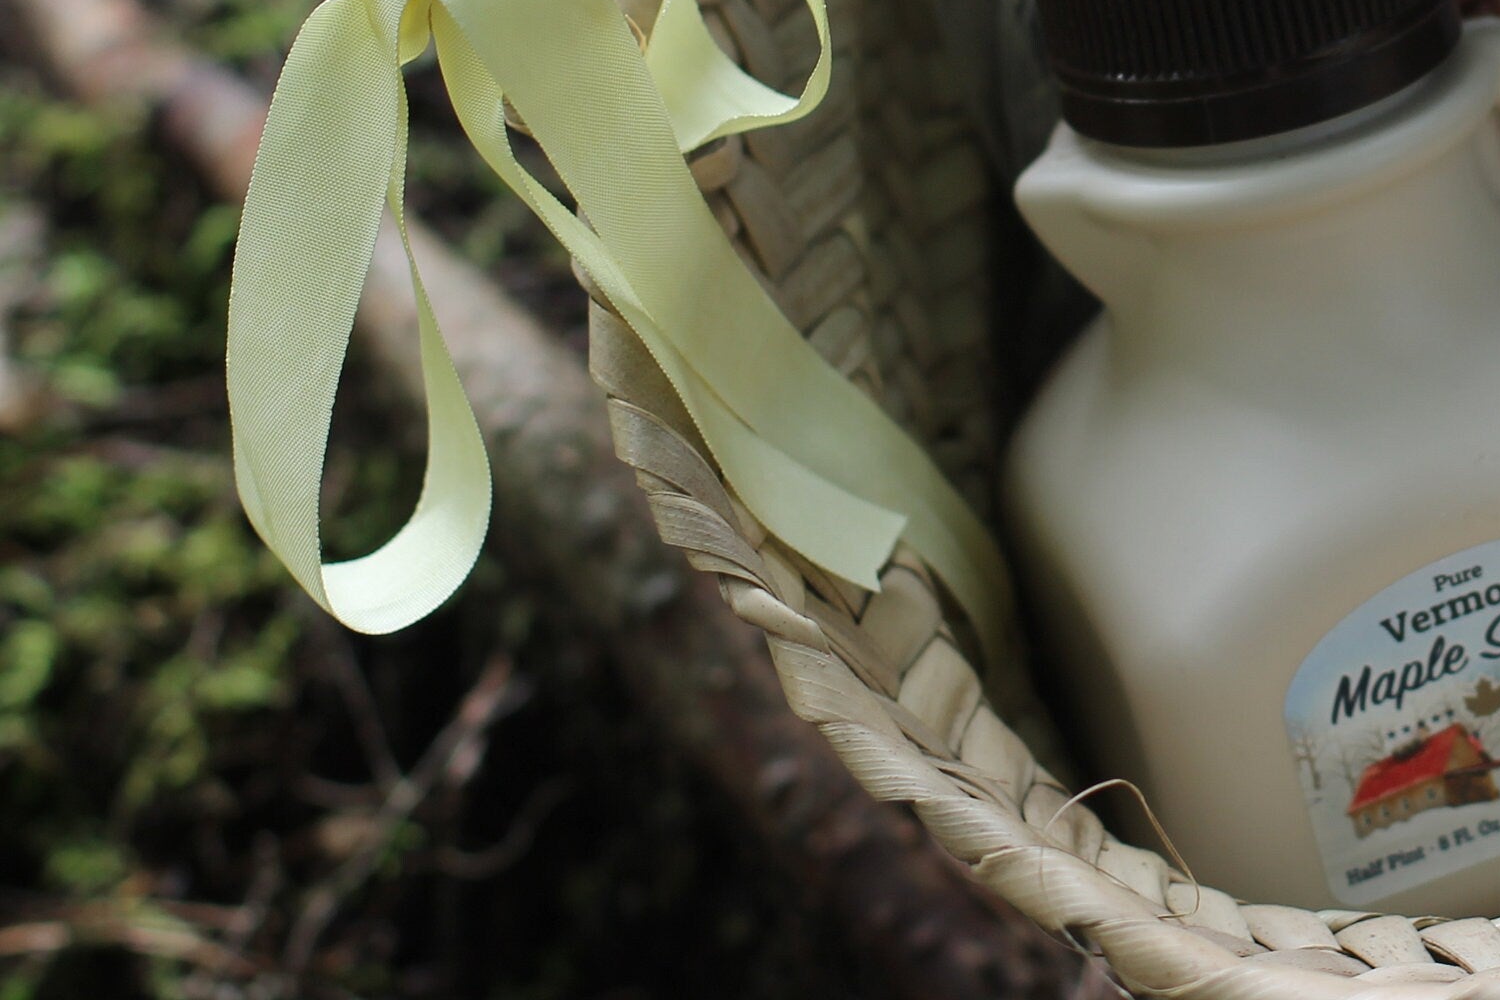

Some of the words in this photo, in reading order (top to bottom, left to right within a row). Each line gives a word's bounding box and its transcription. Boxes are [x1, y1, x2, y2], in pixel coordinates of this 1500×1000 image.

[1434, 565, 1483, 593] Pure
[1331, 636, 1468, 725] Maple
[1346, 859, 1384, 886] Half
[1387, 847, 1425, 870] Pint
[1439, 836, 1449, 850] 8
